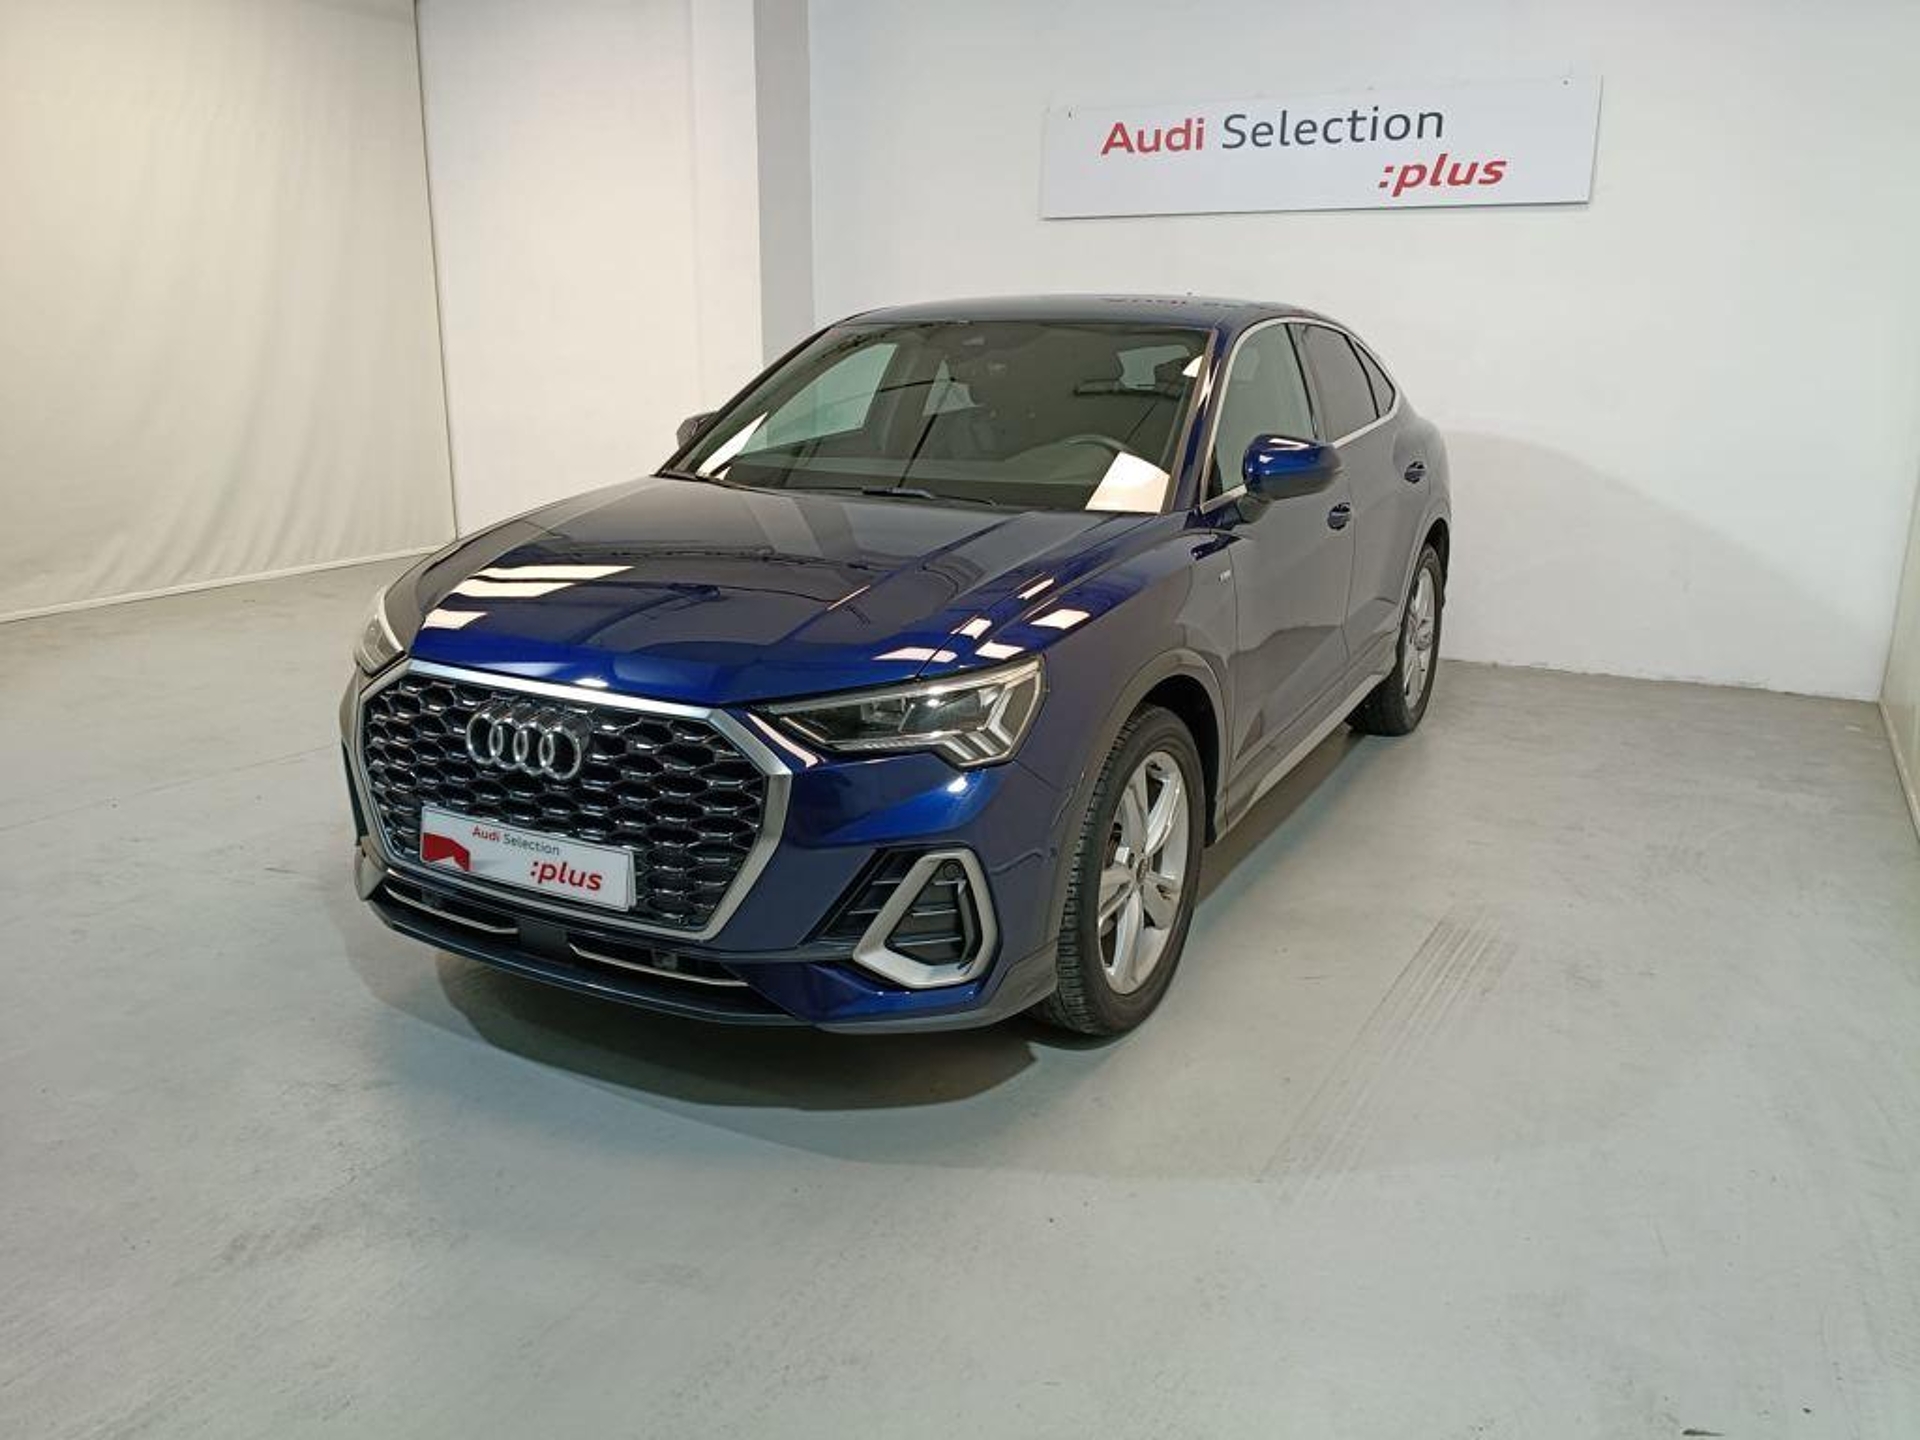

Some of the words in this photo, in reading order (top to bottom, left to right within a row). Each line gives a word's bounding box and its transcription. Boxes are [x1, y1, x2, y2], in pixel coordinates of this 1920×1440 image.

[1101, 118, 1205, 154] Audi
[1222, 106, 1444, 148] Selection
[1378, 153, 1507, 197] :plus
[472, 825, 500, 842] Audi
[503, 833, 560, 855] Selection
[530, 861, 603, 891] :plus
